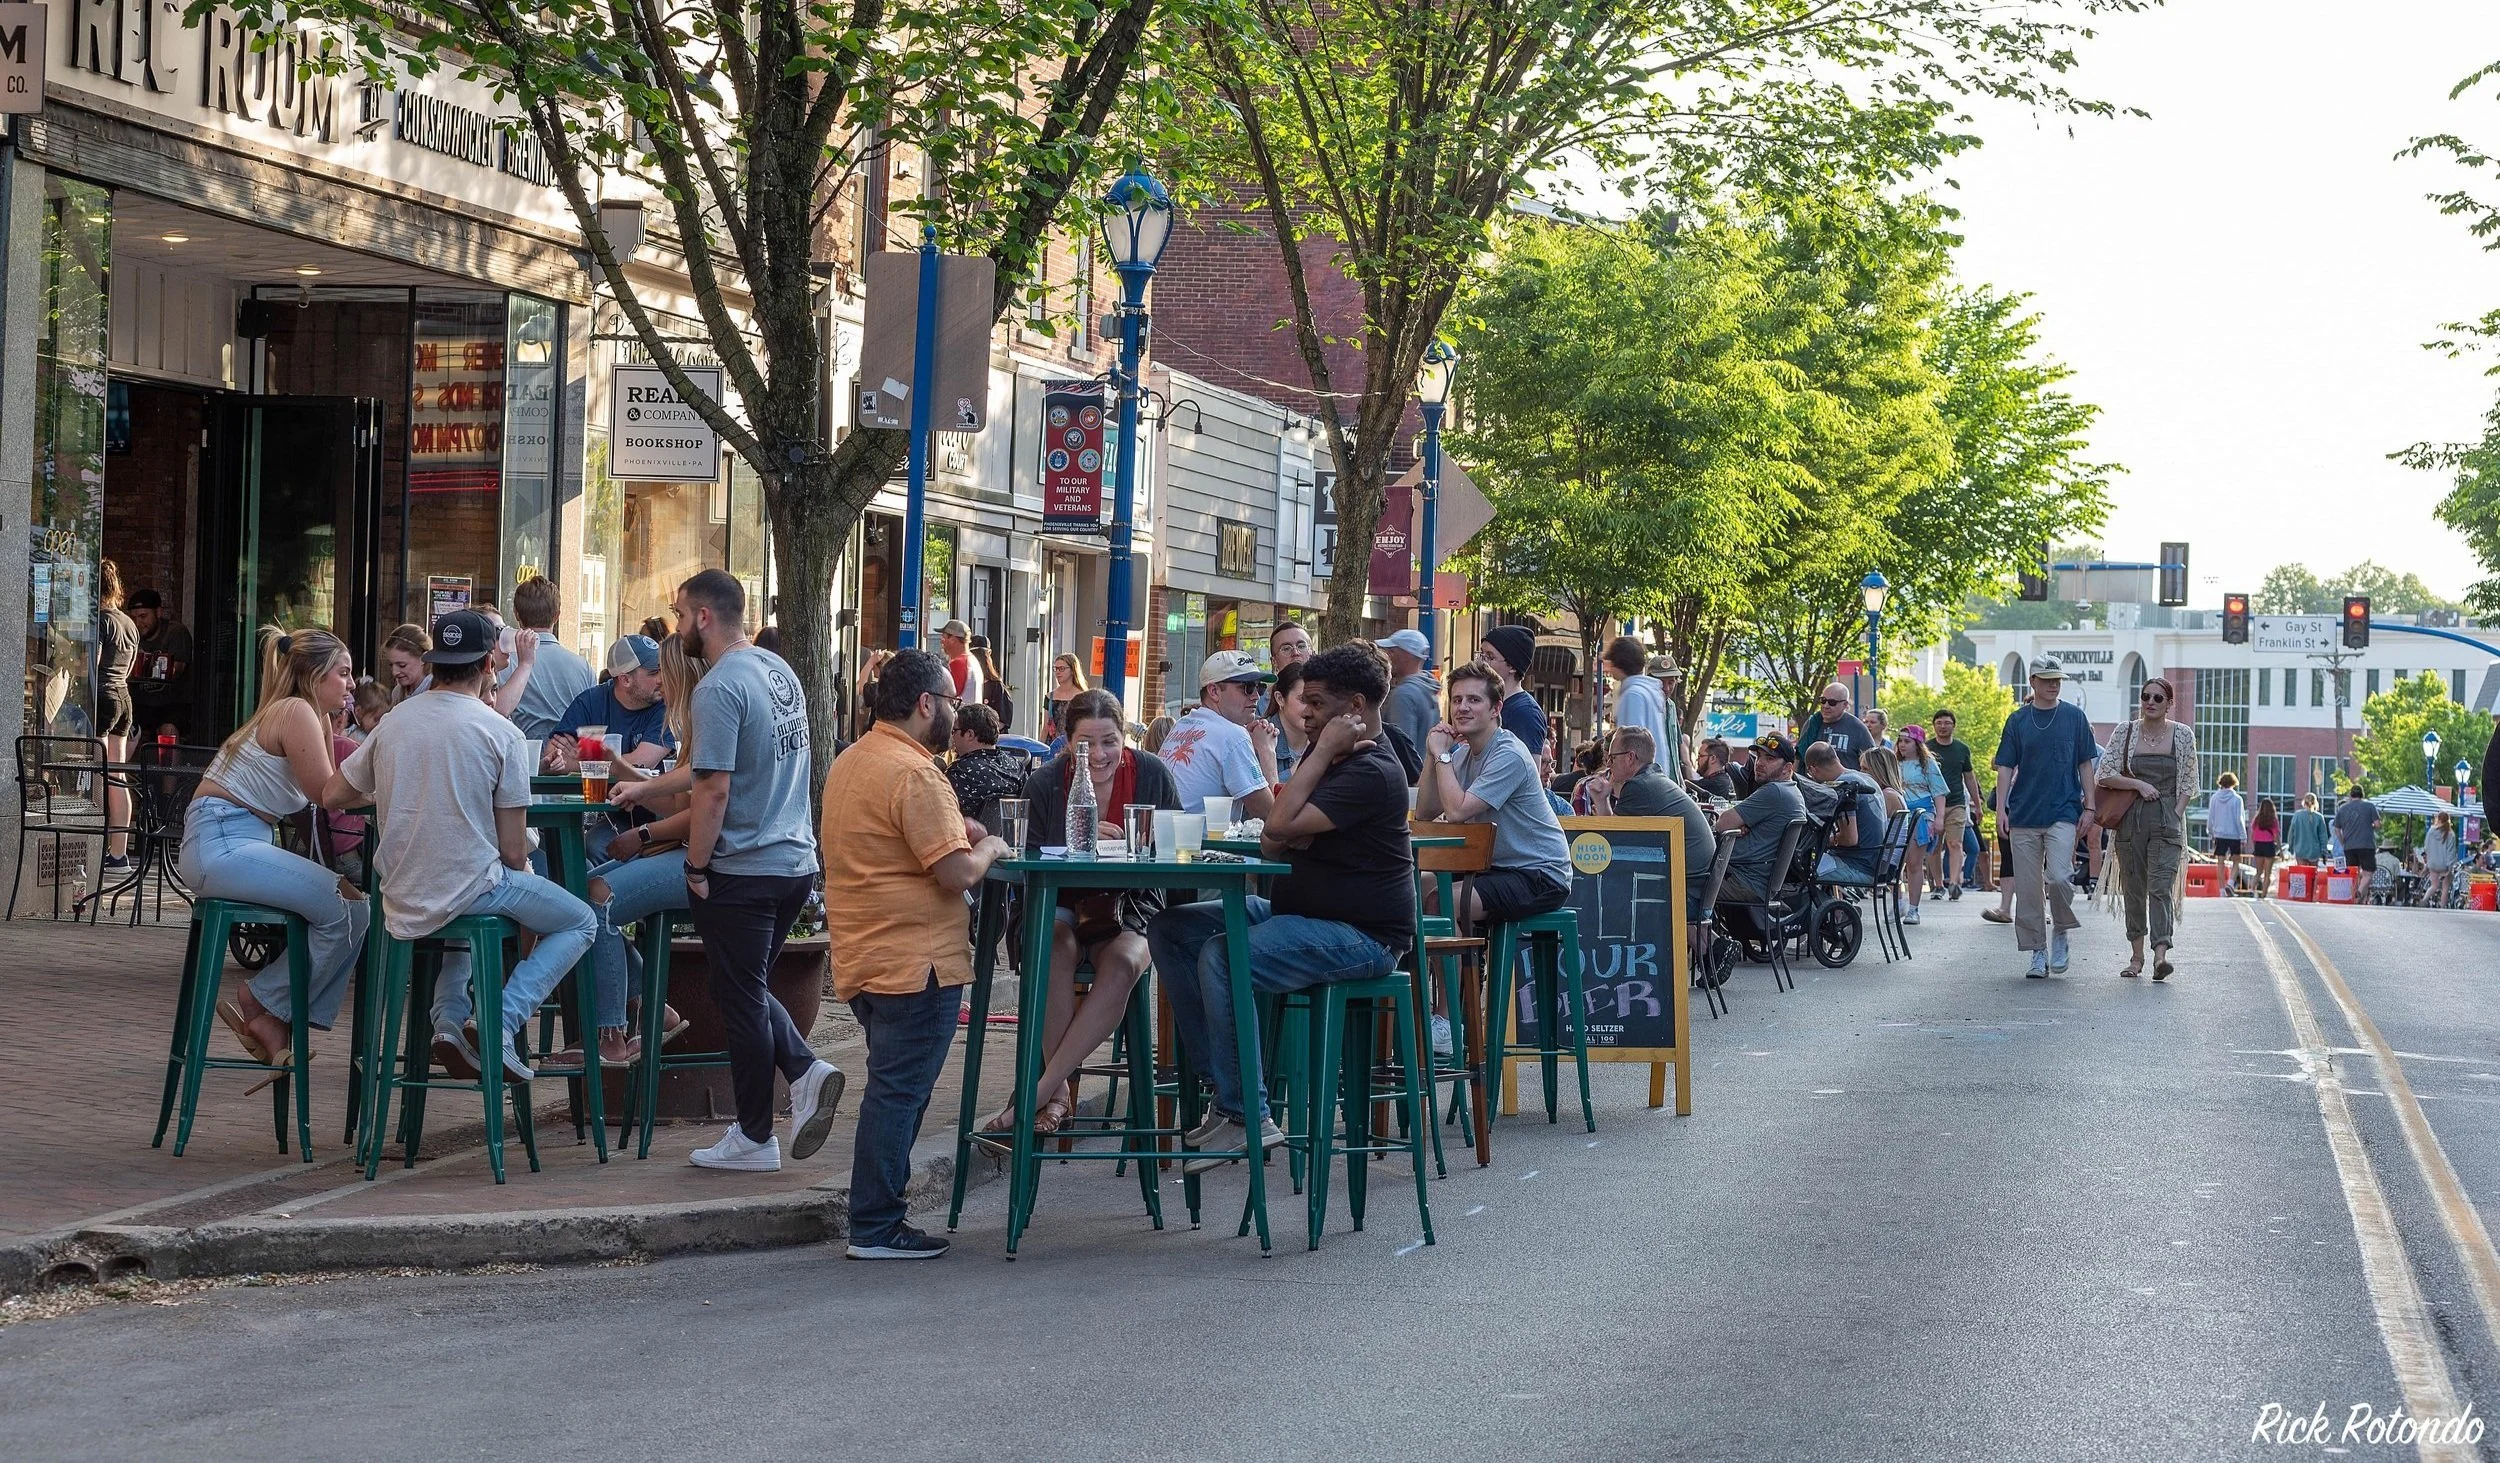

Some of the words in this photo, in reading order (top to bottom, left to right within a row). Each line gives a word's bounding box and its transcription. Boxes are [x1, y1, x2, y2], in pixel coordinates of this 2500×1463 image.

[203, 5, 342, 143] ROOM
[7, 76, 28, 94] CO.
[398, 88, 496, 168] CONSHOHOCKEN
[505, 131, 557, 187] BREWIN
[627, 387, 687, 404] REA
[628, 408, 640, 420] &
[644, 410, 703, 421] COMPAN
[625, 438, 703, 449] BOOKSHOP
[1060, 477, 1070, 485] TO
[1056, 486, 1090, 494] MILITARY
[1064, 495, 1082, 503] AND
[1053, 504, 1092, 512] VETERANS
[1375, 535, 1406, 544] ENJOY
[44, 529, 77, 562] open
[1222, 523, 1256, 574] BREWERY
[2285, 621, 2308, 633] Gay
[2311, 622, 2322, 632] St
[2259, 637, 2301, 648] Franklin
[2304, 638, 2315, 648] St
[2088, 670, 2103, 681] Hall
[777, 716, 808, 737] ALWAYS
[780, 728, 809, 756] ACES
[1577, 844, 1605, 852] HIGH
[1575, 853, 1608, 861] NOON
[1565, 1024, 1589, 1032] HD
[1591, 1024, 1625, 1032] SELTZER
